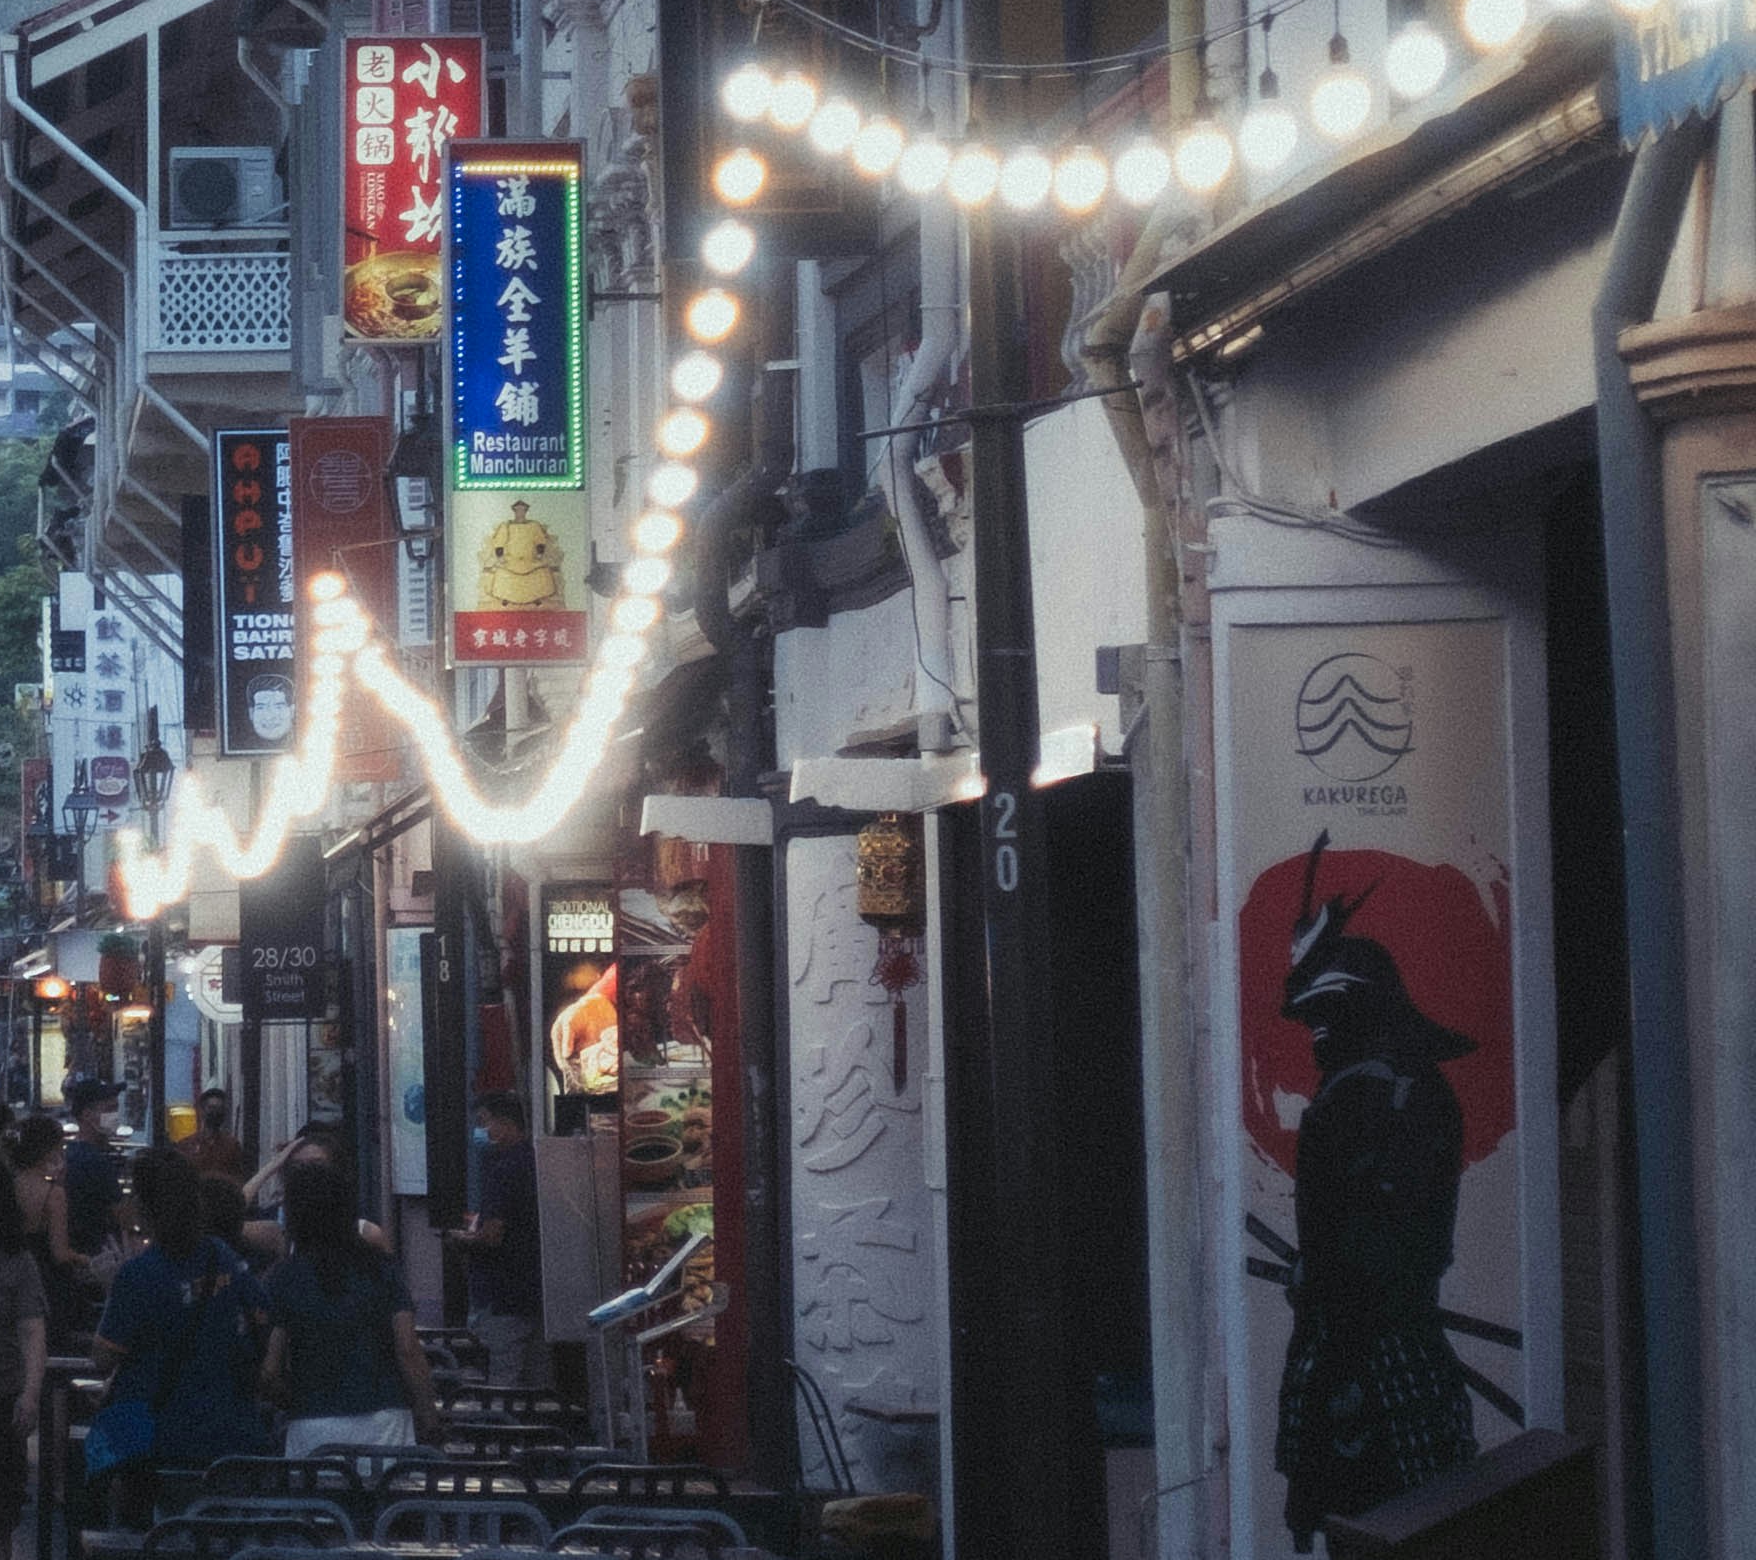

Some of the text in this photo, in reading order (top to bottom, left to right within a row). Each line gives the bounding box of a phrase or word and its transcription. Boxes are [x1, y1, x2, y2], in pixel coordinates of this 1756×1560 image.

[360, 51, 391, 160] 老火锅
[473, 431, 565, 452] Restaurant
[470, 453, 567, 474] Manchurian
[233, 614, 294, 629] TION
[233, 630, 294, 644] BAHR
[233, 646, 294, 661] SATA
[1302, 785, 1407, 805] KAKUREGA
[548, 914, 613, 930] CHENGDU
[252, 945, 317, 969] 28/30
[265, 972, 304, 988] Smith
[265, 989, 305, 1004] Street
